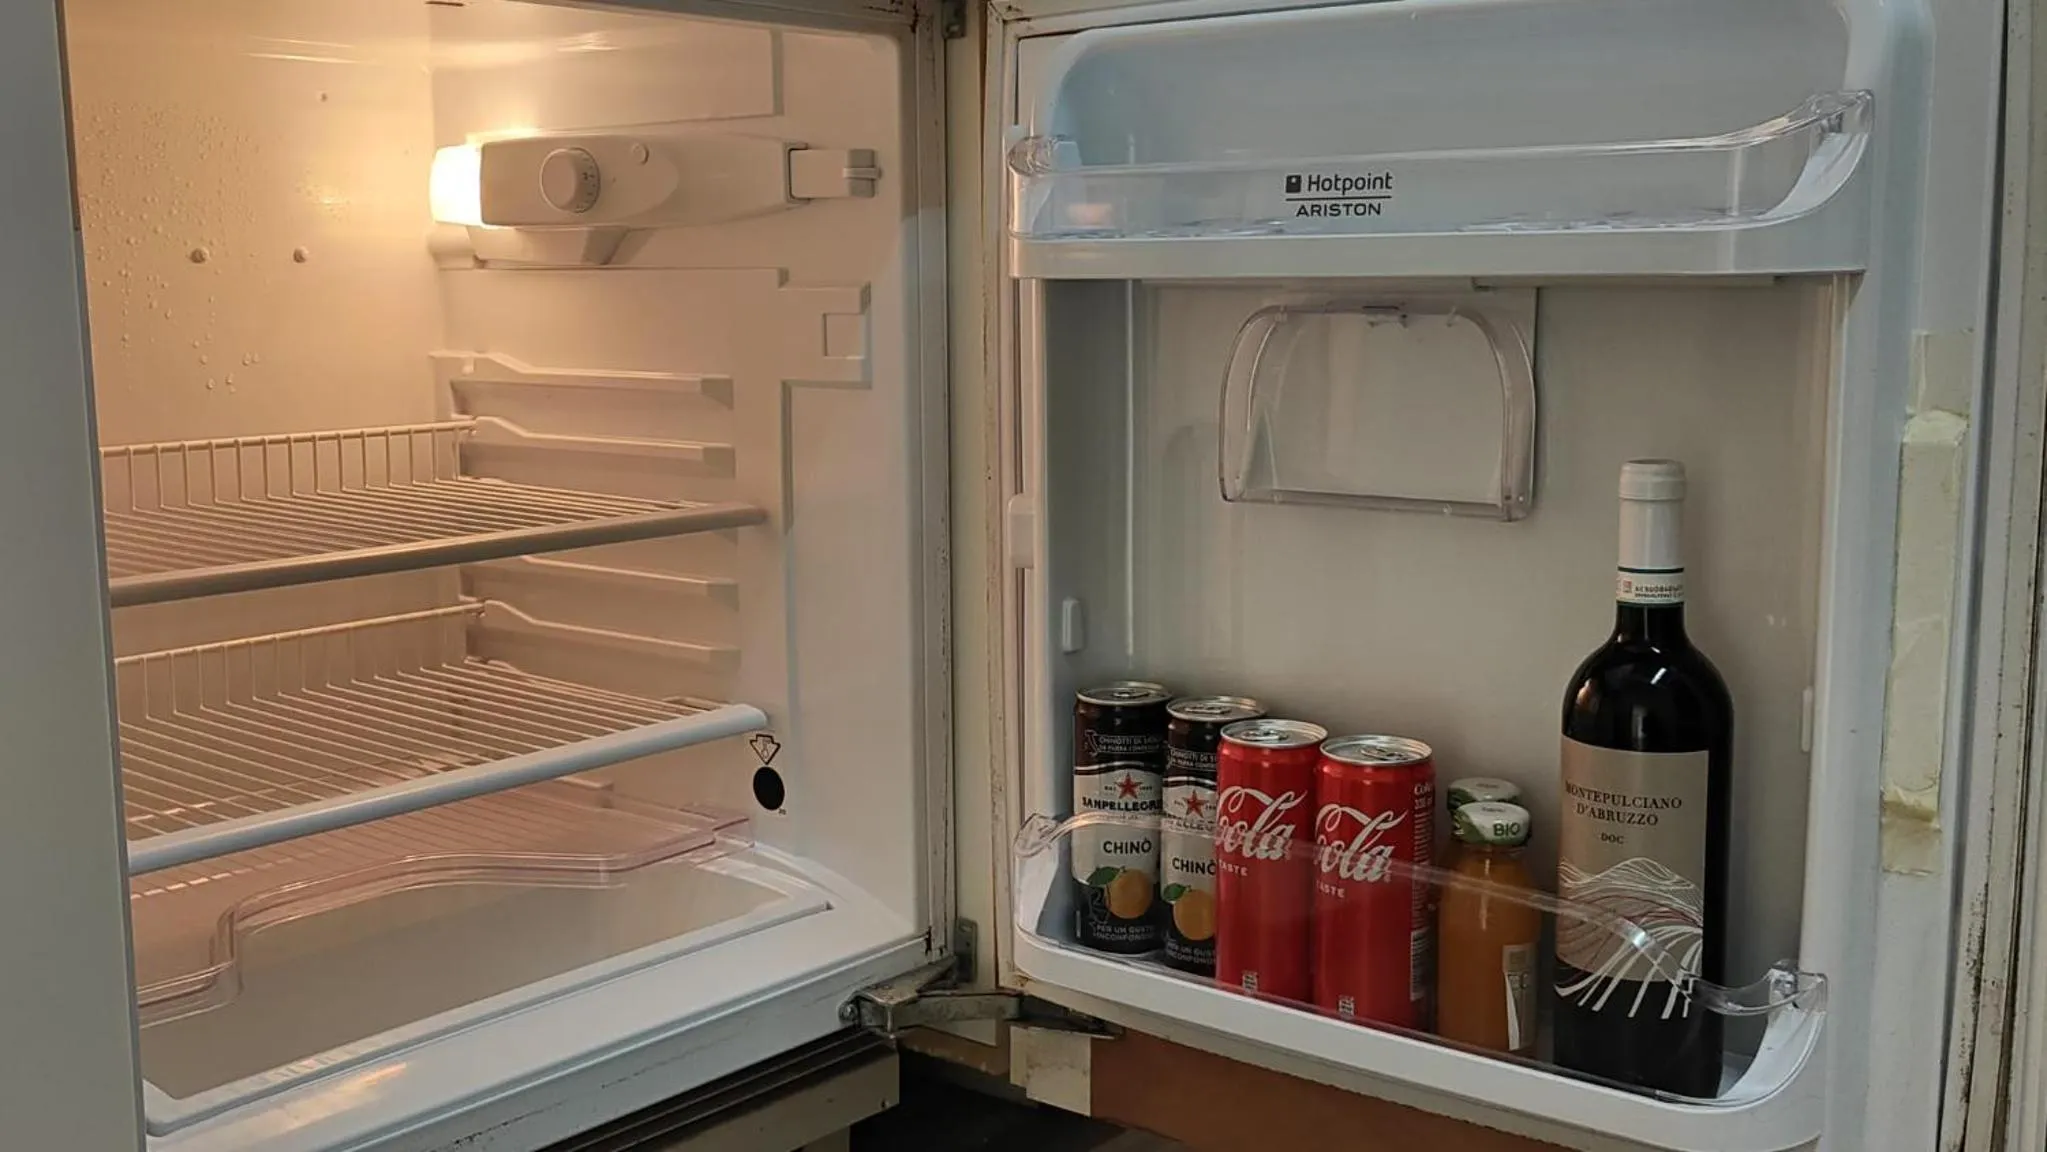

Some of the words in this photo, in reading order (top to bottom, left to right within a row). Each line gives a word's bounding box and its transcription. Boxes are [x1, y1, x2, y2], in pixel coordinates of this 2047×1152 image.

[1307, 172, 1393, 195] Hotpoint
[1295, 203, 1382, 217] ARISTON
[1565, 780, 1682, 809] MONTEPULCIANO
[1576, 803, 1659, 826] D'ABRUZZO
[1493, 823, 1521, 837] BIO
[1601, 832, 1624, 844] DOC
[1317, 880, 1345, 898] ASTE
